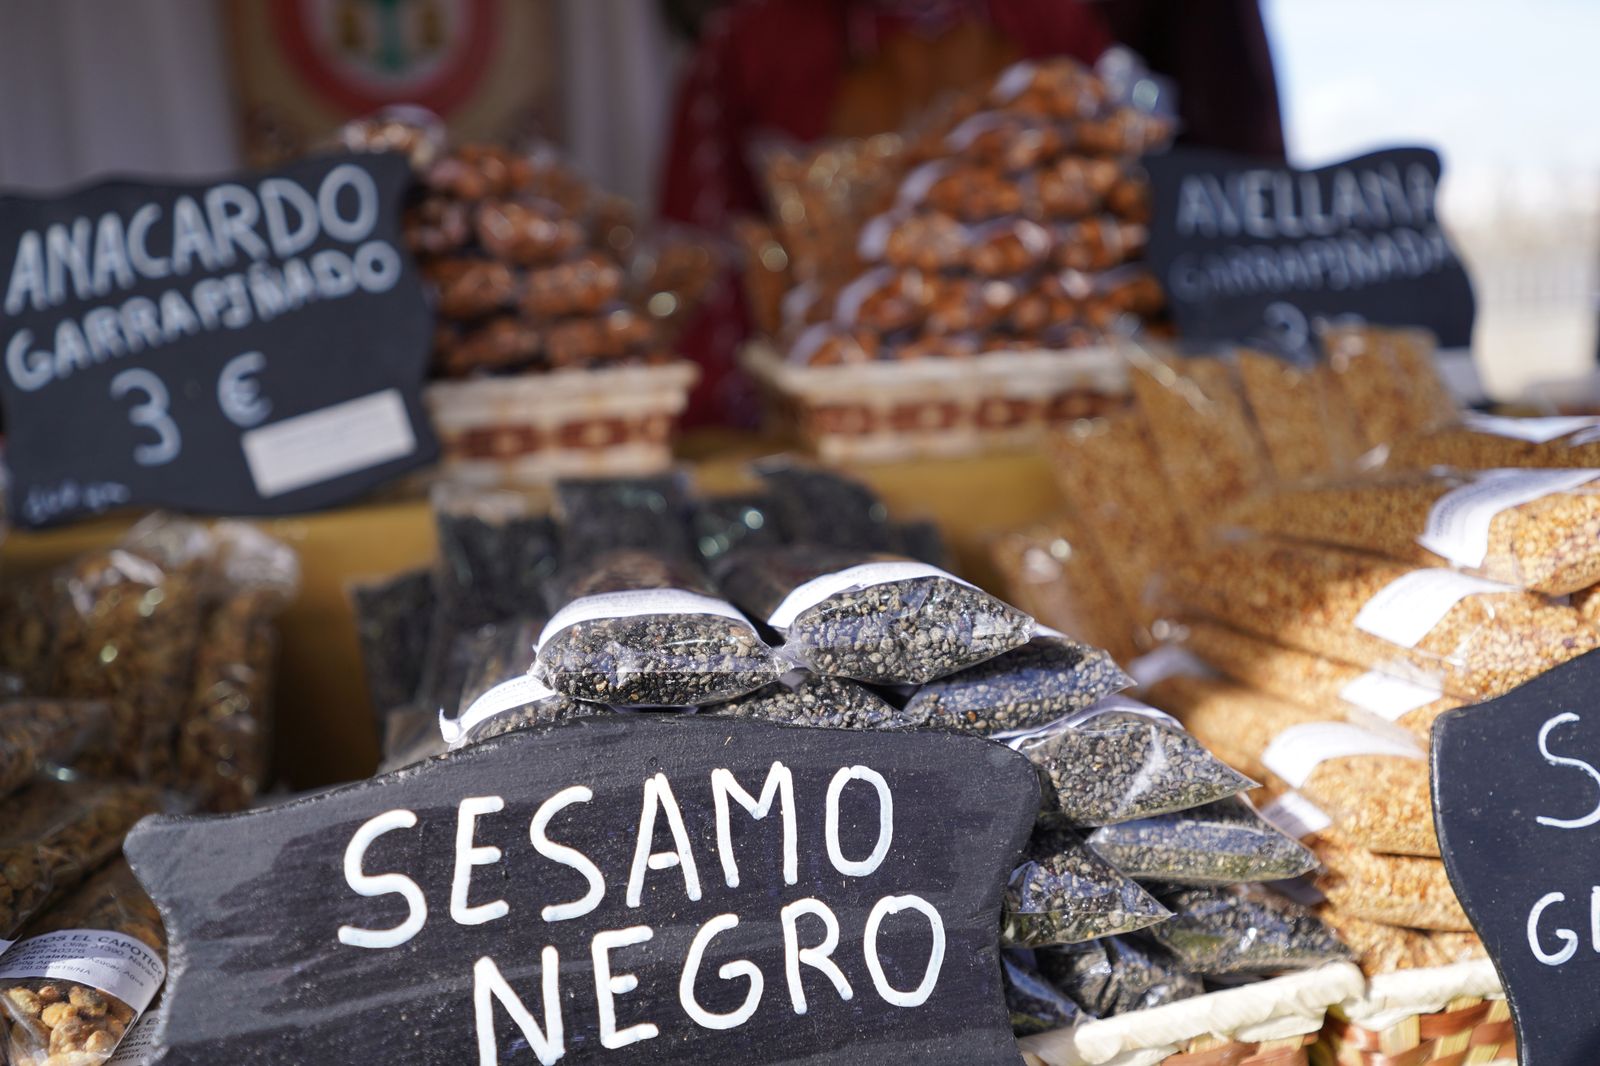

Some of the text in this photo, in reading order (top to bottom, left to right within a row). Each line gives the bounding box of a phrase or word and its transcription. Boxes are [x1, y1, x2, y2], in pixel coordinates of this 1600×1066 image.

[4, 164, 379, 316] ANACARDO
[6, 240, 402, 392] GARRAPIÑADO
[110, 367, 182, 467] 3
[338, 762, 894, 949] SESAMO
[72, 934, 92, 943] EL
[474, 895, 946, 1066] NEGRO
